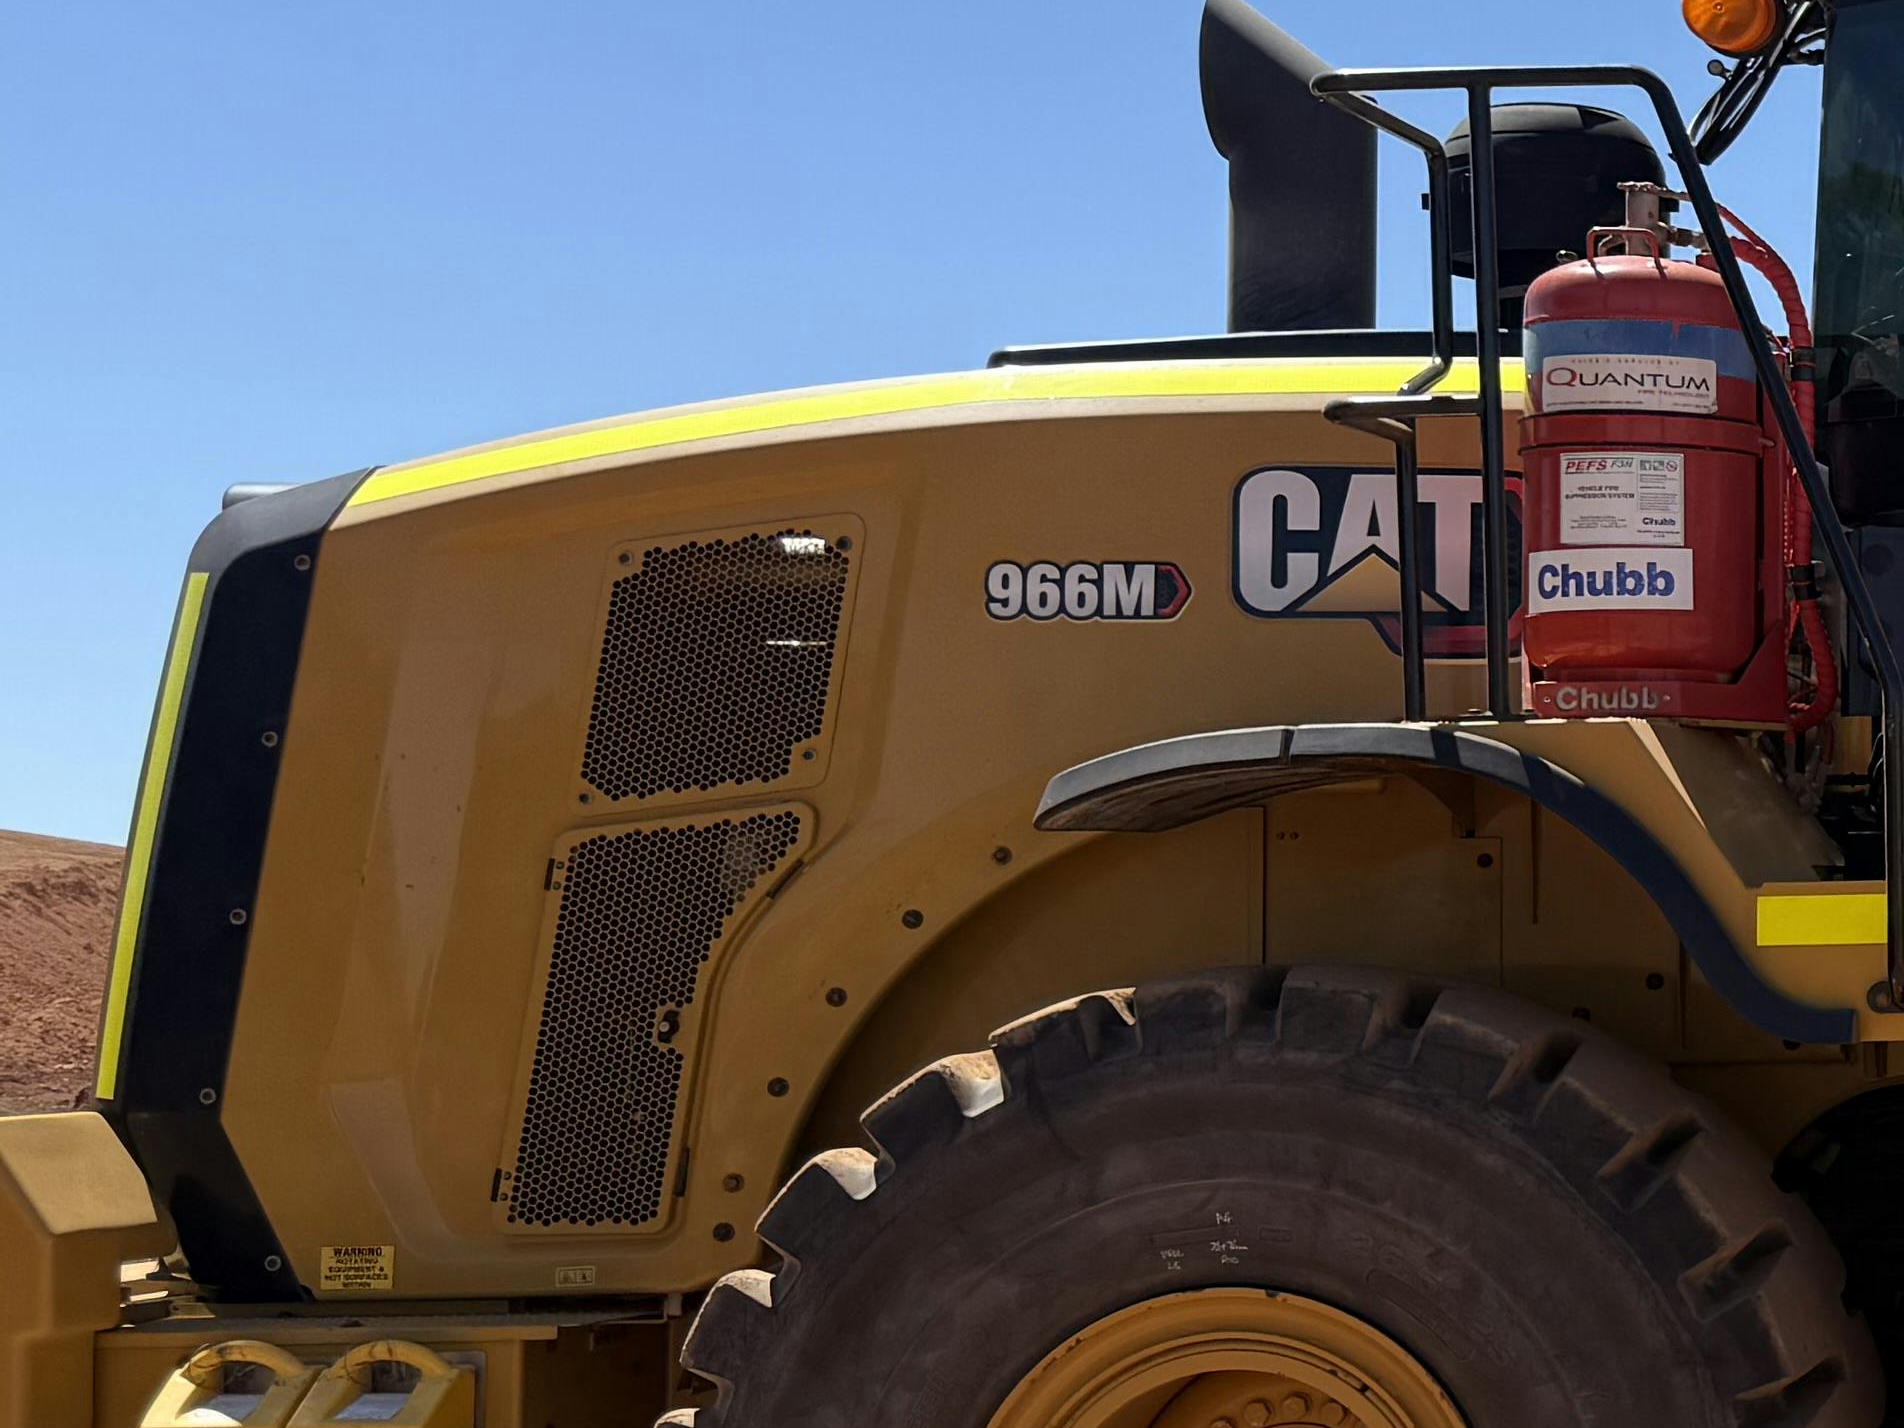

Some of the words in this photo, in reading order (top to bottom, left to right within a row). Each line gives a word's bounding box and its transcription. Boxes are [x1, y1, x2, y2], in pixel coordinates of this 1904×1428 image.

[1546, 367, 1710, 392] QUANTUM
[1565, 459, 1608, 472] PEFS
[1642, 517, 1677, 526] Chubb
[1238, 469, 1484, 612] CAT
[987, 563, 1155, 617] 966M
[1537, 561, 1675, 600] Chubb
[1556, 686, 1660, 711] Chubb
[333, 1247, 383, 1257] WARNING
